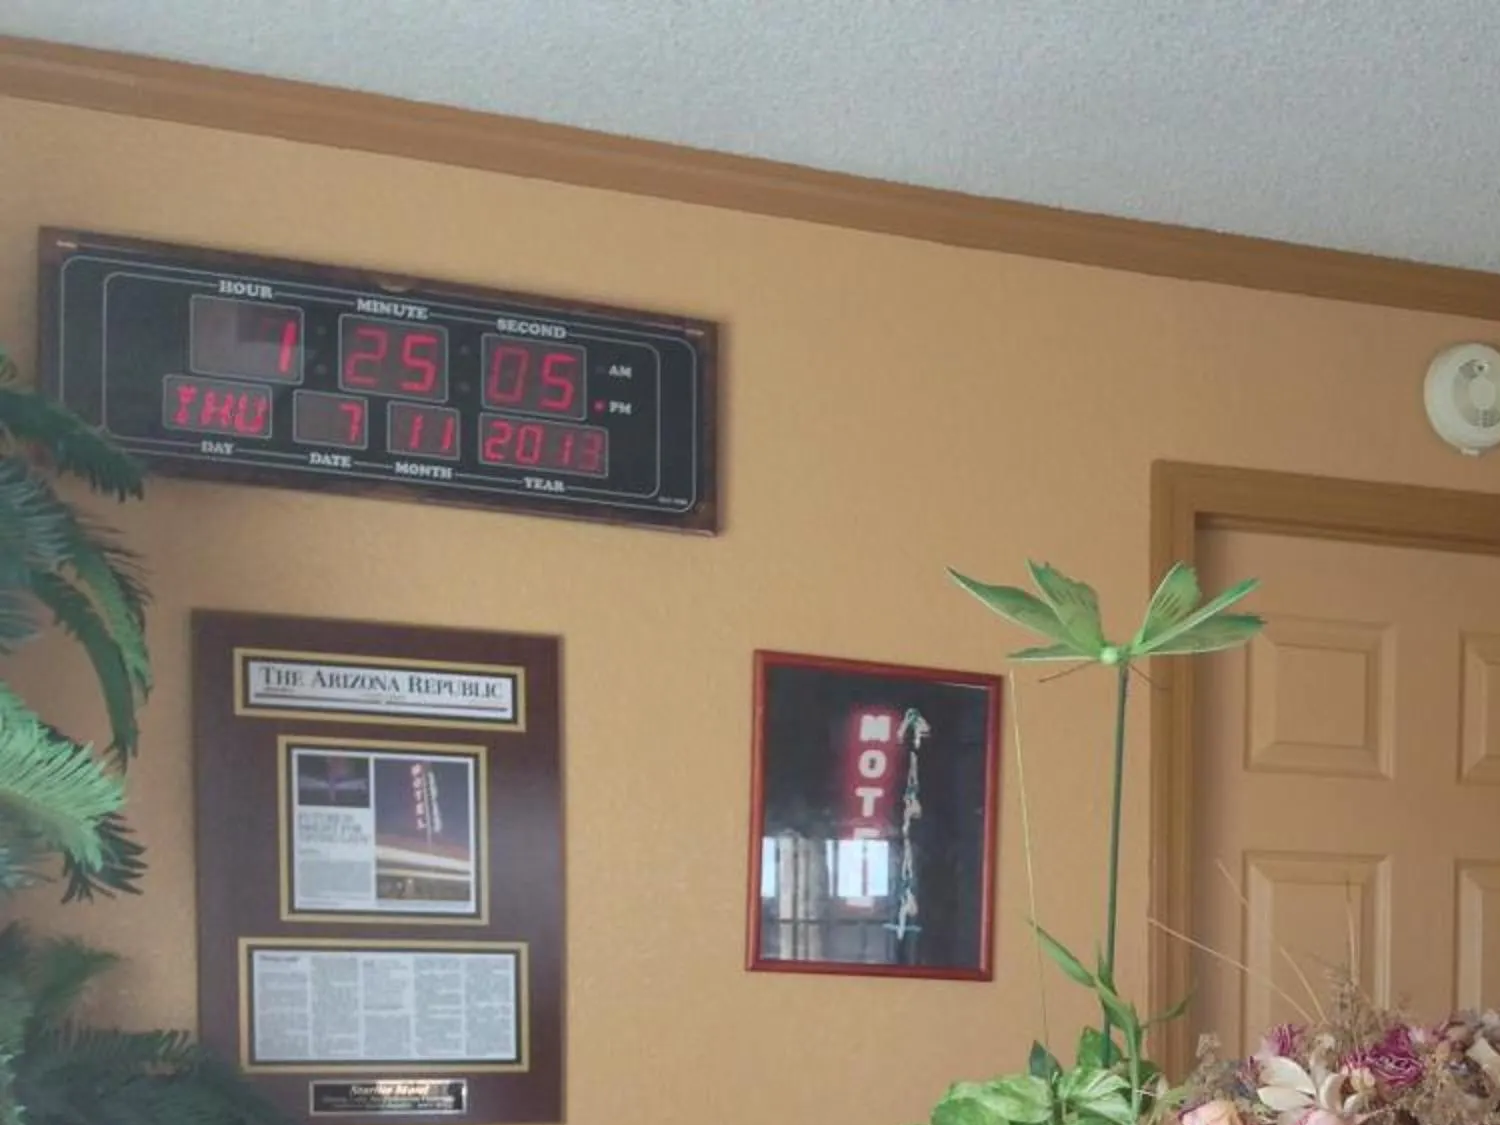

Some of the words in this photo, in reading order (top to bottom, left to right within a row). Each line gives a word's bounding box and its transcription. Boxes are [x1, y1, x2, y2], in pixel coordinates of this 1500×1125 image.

[219, 280, 272, 299] HOUR
[357, 298, 428, 320] MINUTE
[496, 318, 567, 339] SECOND
[279, 319, 298, 373] 1
[345, 327, 438, 393] 25
[489, 345, 577, 410] 05
[609, 364, 632, 379] AM
[171, 384, 268, 434] THU
[340, 403, 363, 442] 7
[409, 412, 455, 451] 11
[483, 419, 603, 477] 2013
[609, 402, 632, 415] PM
[201, 440, 234, 456] DAY
[309, 452, 351, 468] DATE
[395, 461, 452, 479] MONTH
[523, 476, 565, 493] YEAR
[260, 666, 302, 688] THE
[311, 670, 400, 693] ARIZONA
[408, 675, 503, 699] REPUBLIC
